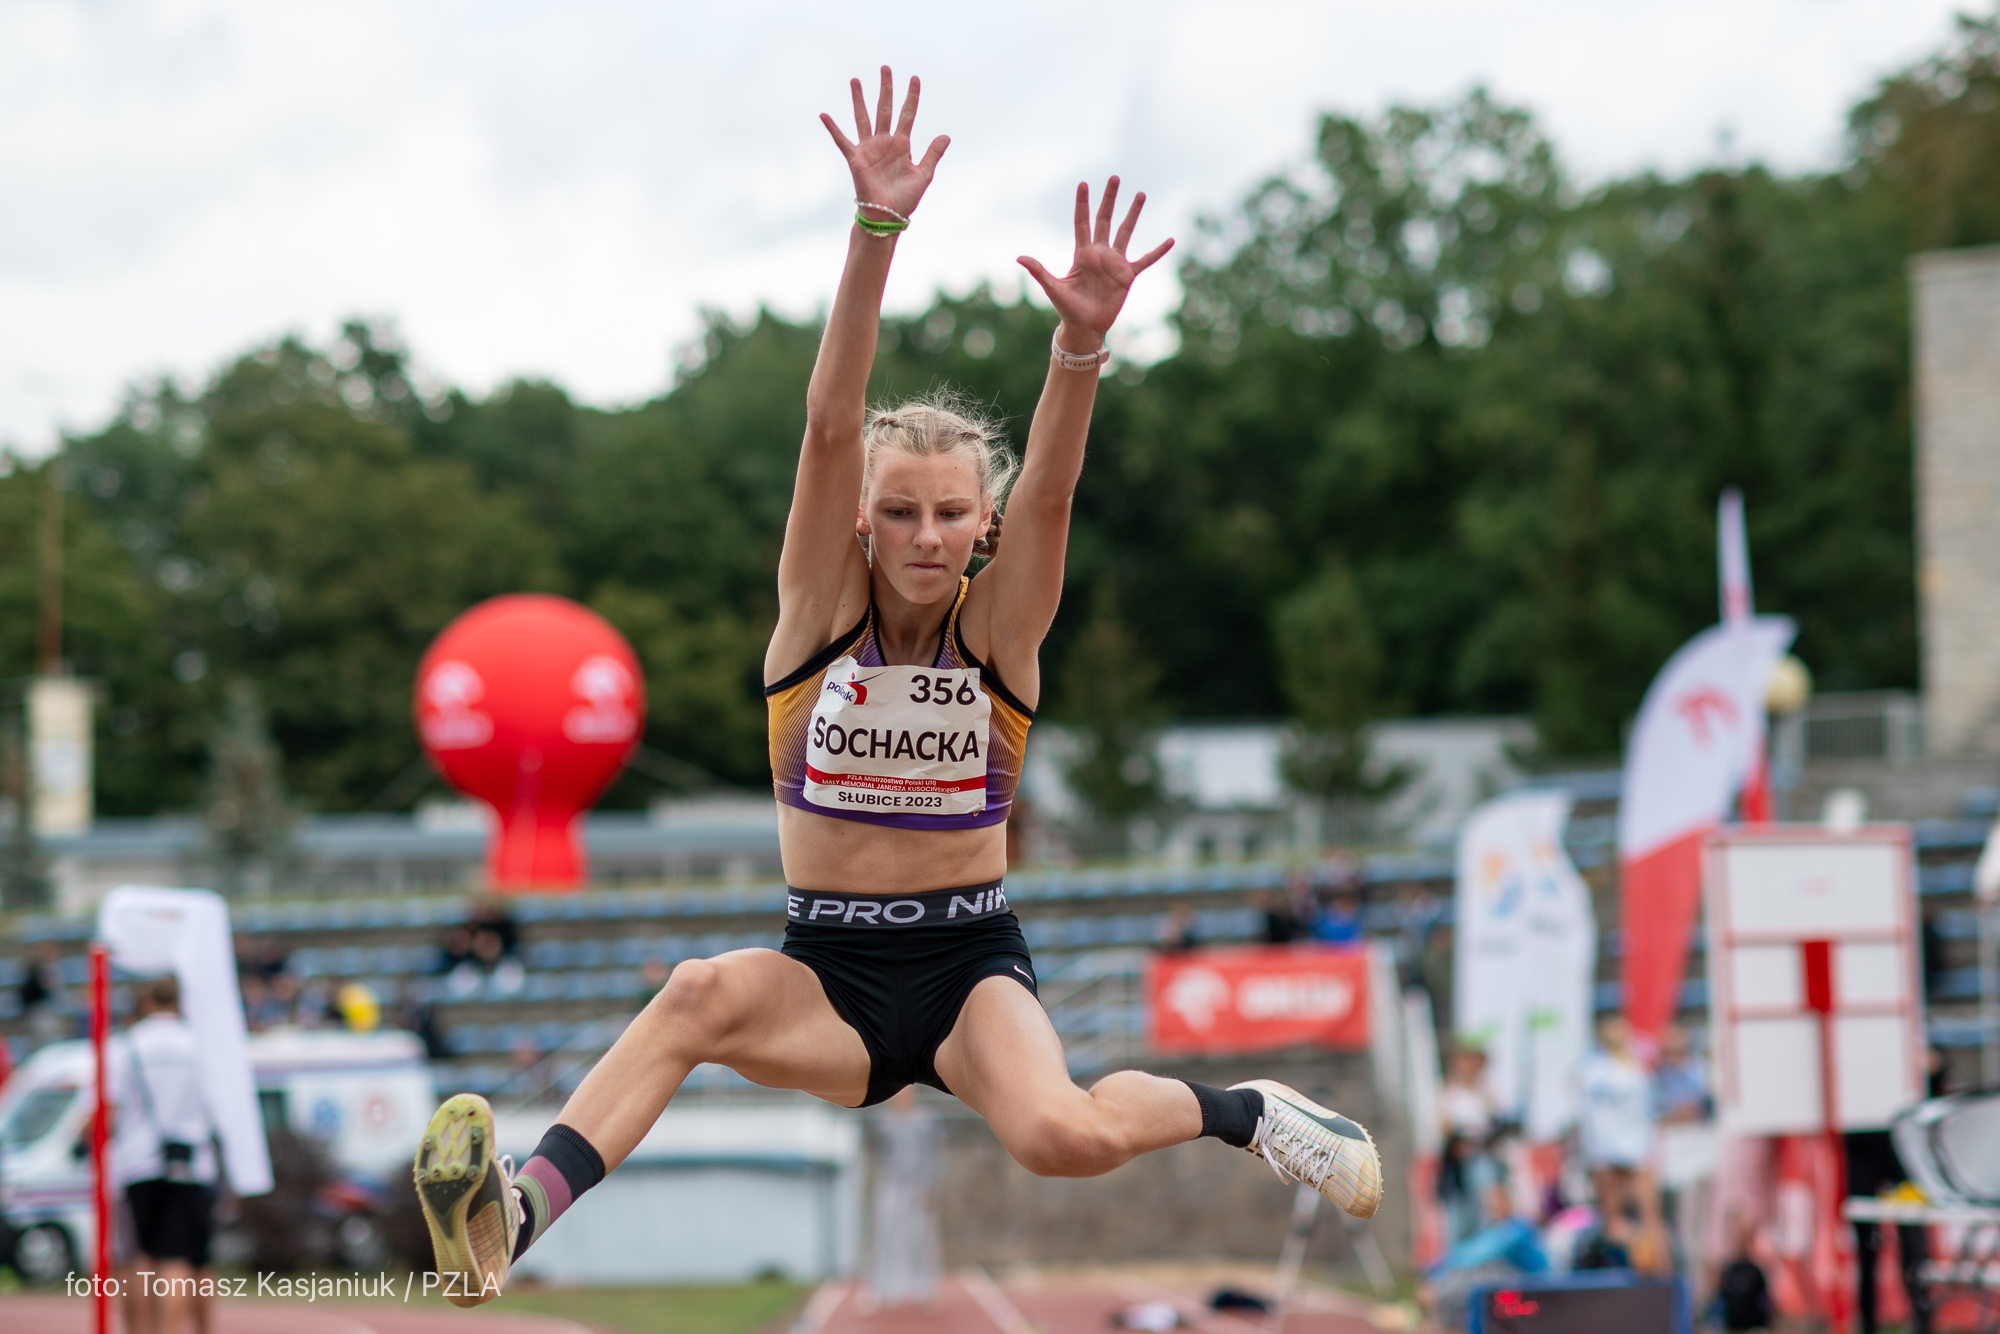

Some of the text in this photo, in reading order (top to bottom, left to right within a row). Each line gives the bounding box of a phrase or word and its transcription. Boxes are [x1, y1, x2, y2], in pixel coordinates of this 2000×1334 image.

[909, 674, 976, 706] 356
[813, 716, 979, 762] SOCHACKA
[841, 780, 875, 789] MEMORIAŁ
[876, 784, 906, 792] JANUSZA
[907, 786, 960, 794] KUSOCIŃSKIEGO
[864, 776, 903, 785] Mistrzostwa
[838, 791, 943, 808] SŁUBICE 2023
[808, 899, 925, 924] PRO
